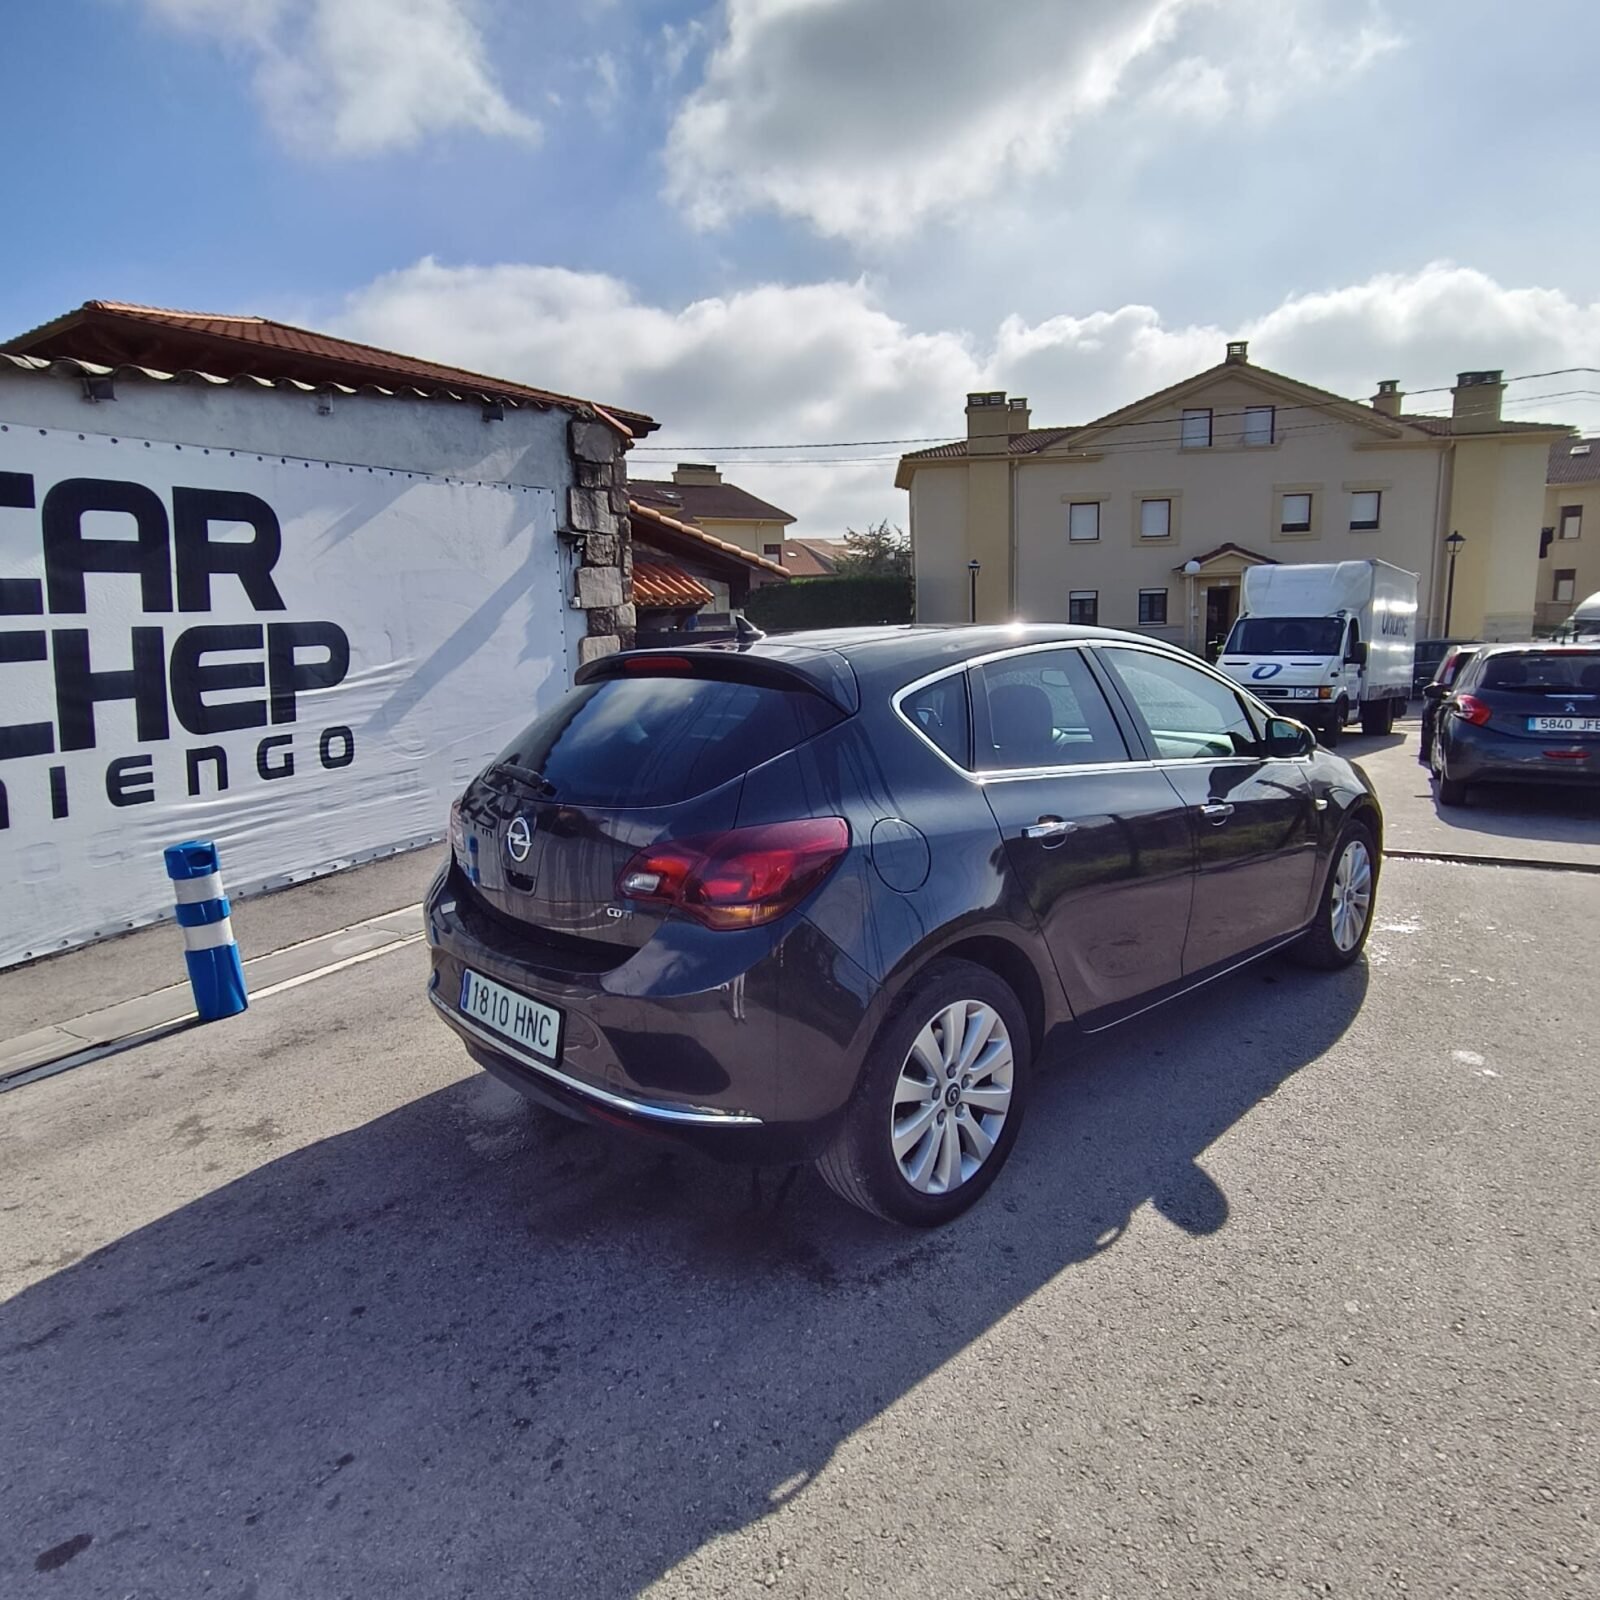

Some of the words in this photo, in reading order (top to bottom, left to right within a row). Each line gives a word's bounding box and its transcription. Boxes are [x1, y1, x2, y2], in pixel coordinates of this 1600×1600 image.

[1540, 718, 1573, 730] 5840
[0, 725, 355, 830] IENGO
[473, 981, 509, 1027] 1810
[514, 1001, 551, 1047] HNC
